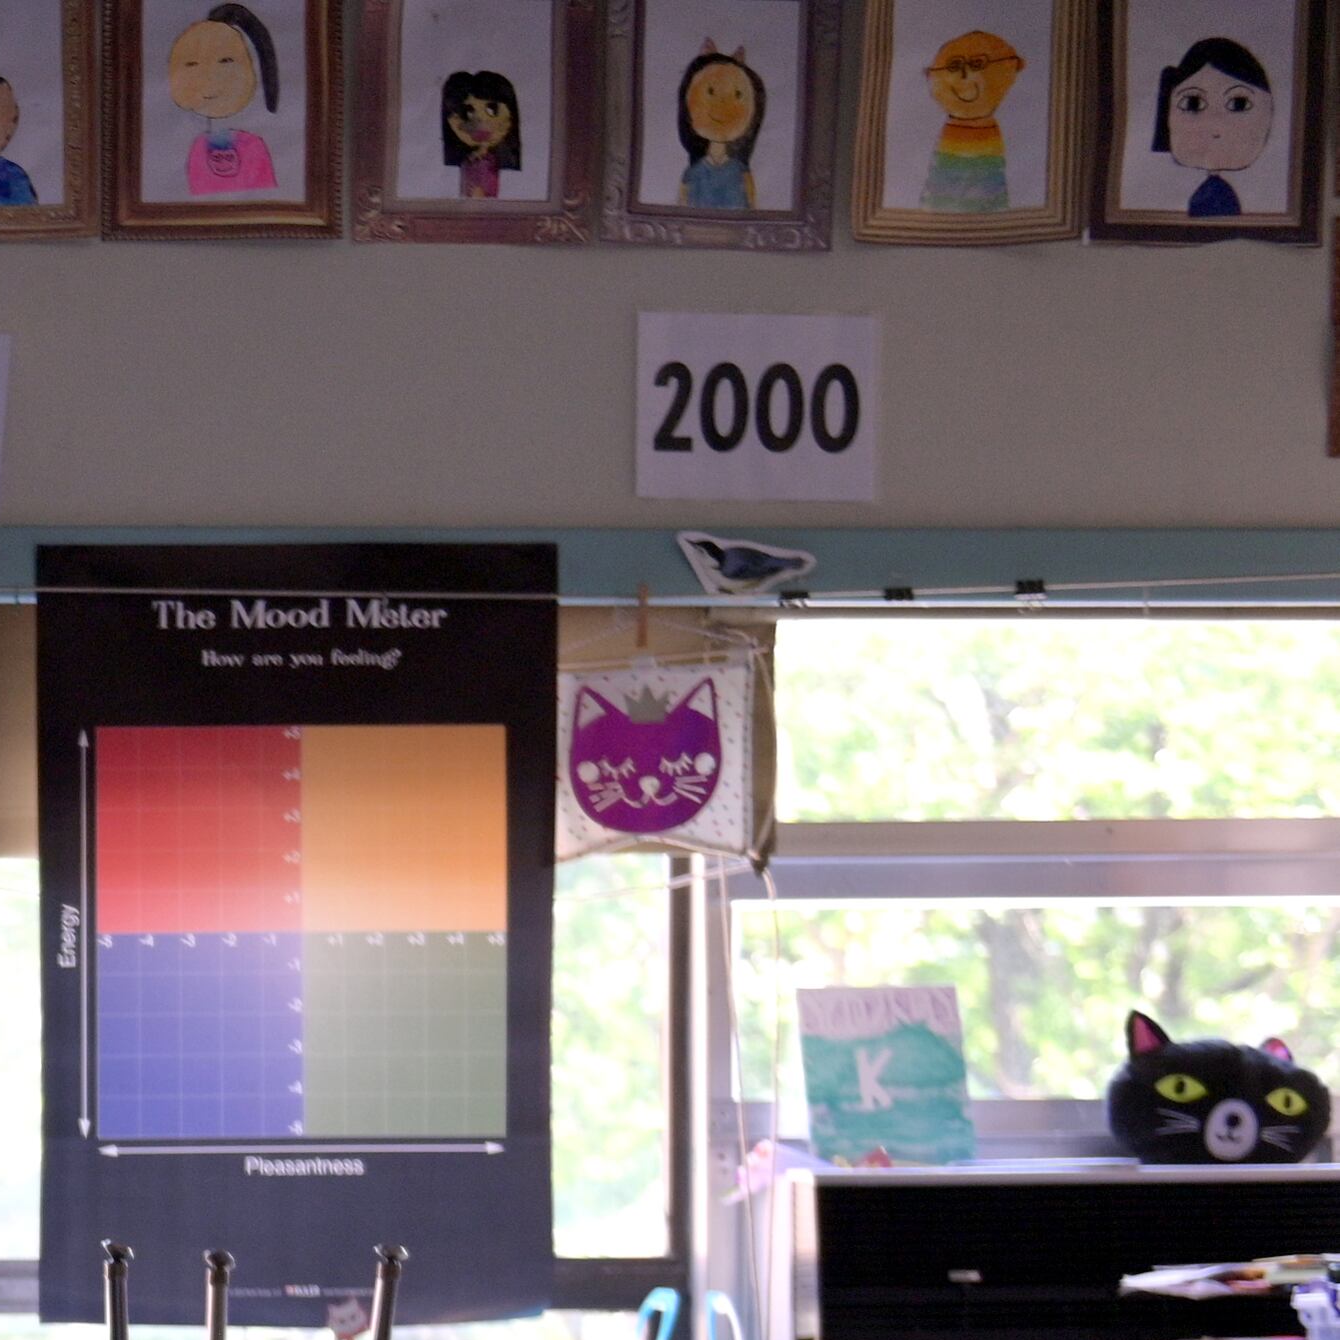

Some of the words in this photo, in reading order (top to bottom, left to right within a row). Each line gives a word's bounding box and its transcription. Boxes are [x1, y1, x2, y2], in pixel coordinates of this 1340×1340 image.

[652, 362, 860, 453] 2000
[152, 601, 215, 628] The
[229, 599, 329, 629] Mood
[345, 599, 447, 629] Meter
[201, 649, 245, 667] How
[251, 653, 284, 667] are
[289, 653, 324, 670] you
[331, 649, 402, 669] feeling?
[56, 903, 80, 969] Energy
[856, 1047, 894, 1111] K
[245, 1155, 367, 1176] Pleasantness
